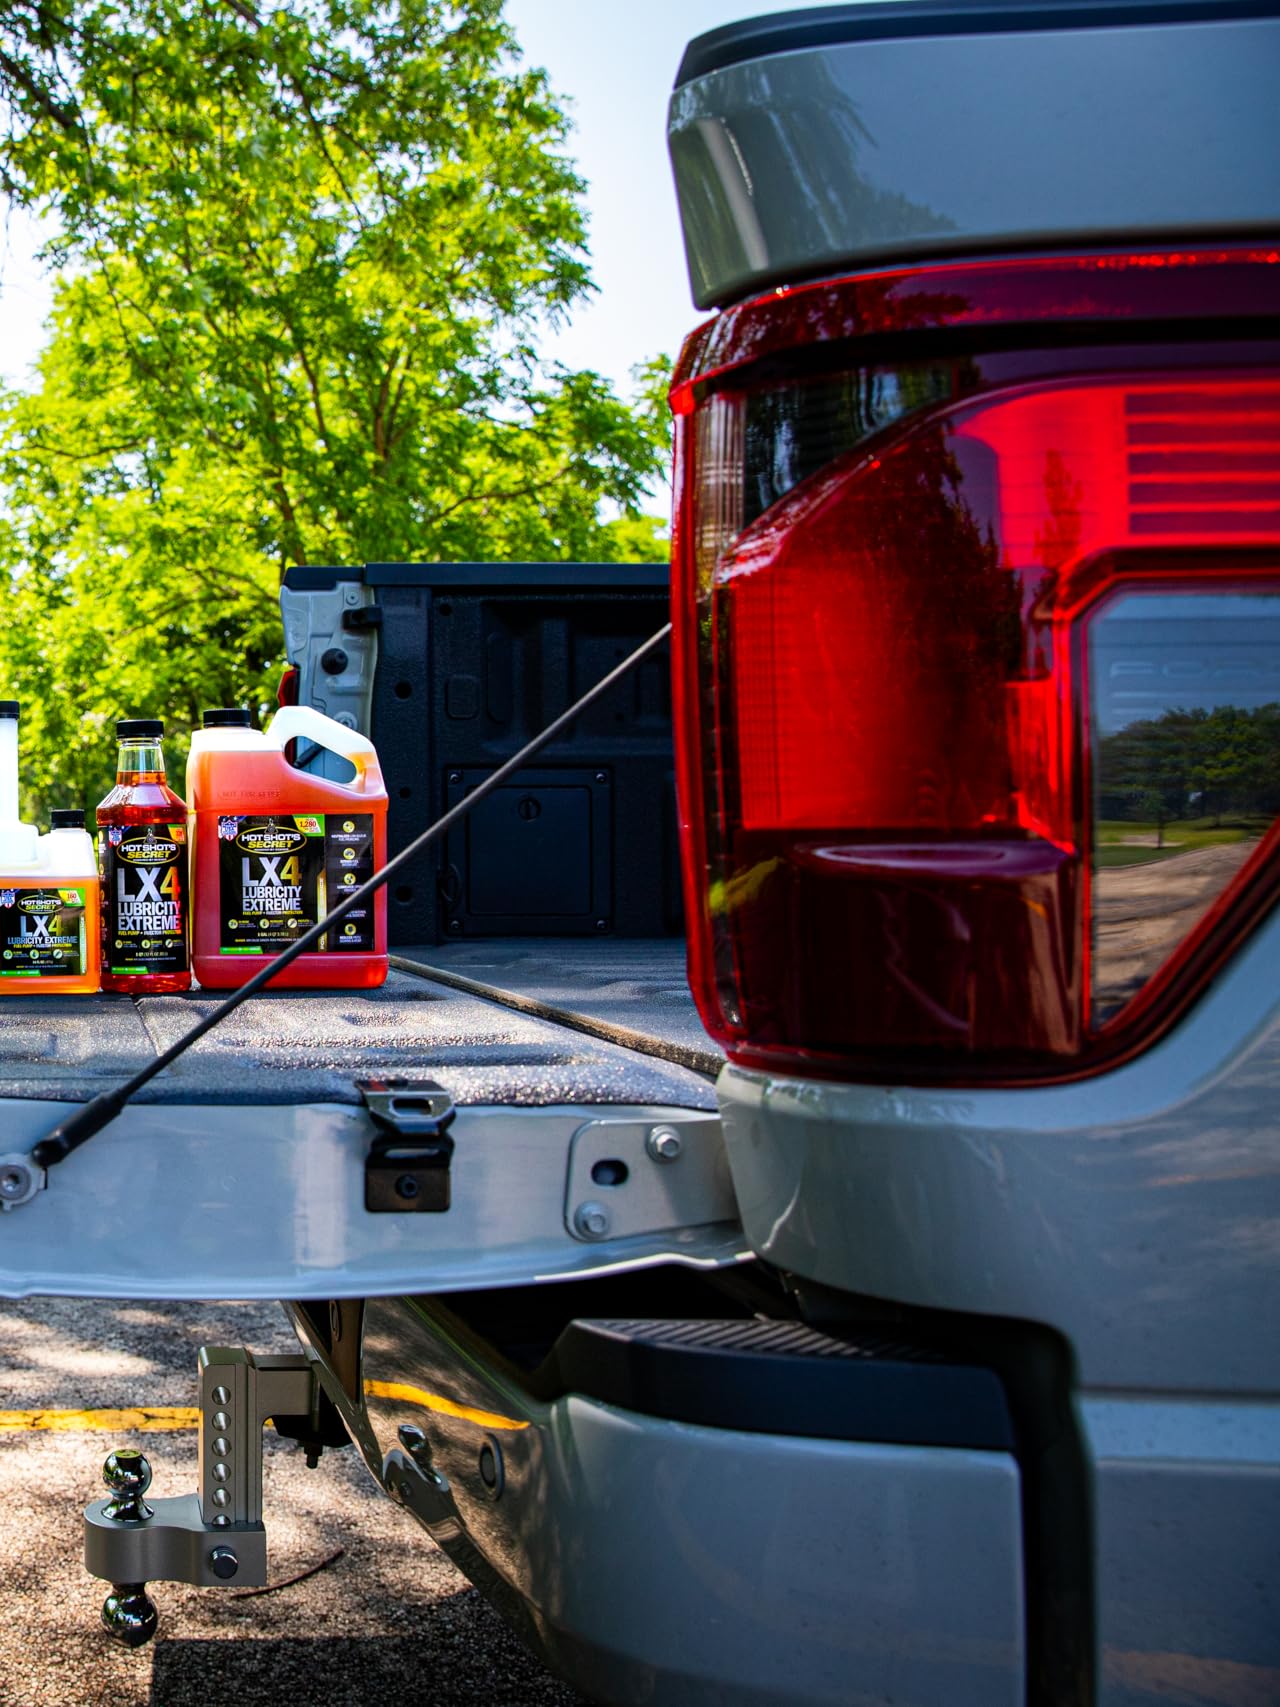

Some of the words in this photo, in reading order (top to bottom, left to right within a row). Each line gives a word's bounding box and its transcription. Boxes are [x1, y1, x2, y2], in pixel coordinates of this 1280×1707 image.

[264, 833, 301, 841] SHOT'S
[121, 844, 142, 852] HOT
[142, 843, 176, 851] SHOT'S
[248, 840, 294, 848] SECRET
[127, 851, 171, 859] SECRET
[241, 856, 302, 886] LX4
[117, 866, 180, 901] LX4
[242, 886, 302, 899] LUBRICITY
[118, 901, 181, 916] LUBRICITY
[242, 898, 301, 911] EXTREME
[20, 915, 64, 937] LX4
[118, 915, 181, 930] EXTREME
[8, 936, 43, 944] LUBRICITY
